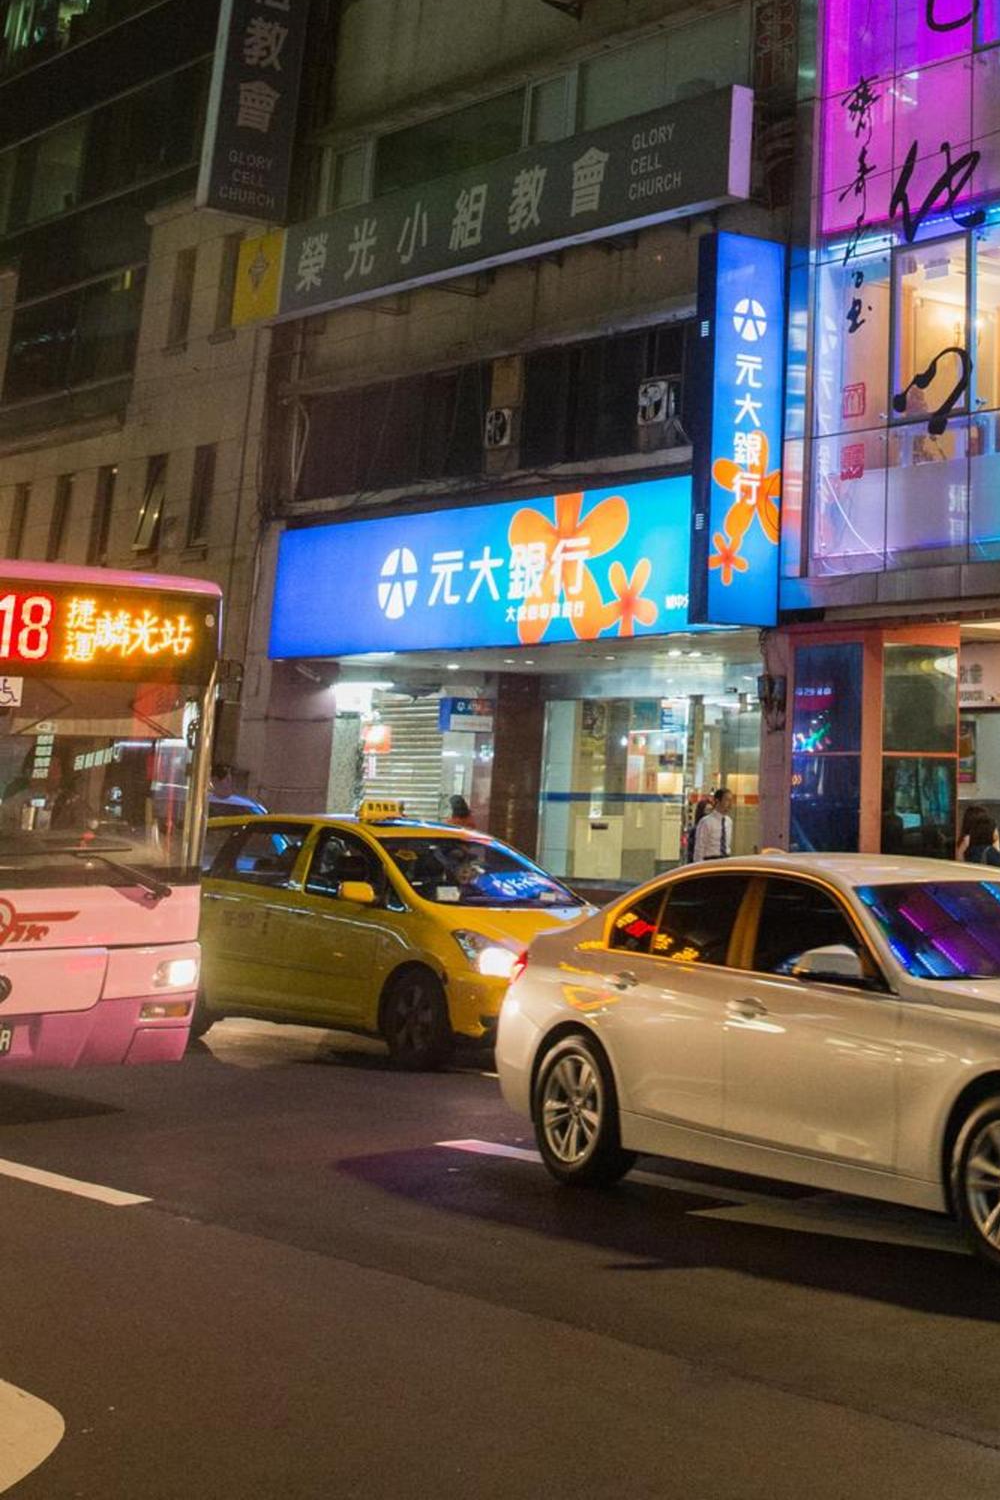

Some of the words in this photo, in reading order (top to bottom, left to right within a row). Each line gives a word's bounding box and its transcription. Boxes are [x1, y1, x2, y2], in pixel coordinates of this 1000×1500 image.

[632, 123, 675, 151] GLORY
[228, 149, 273, 172] GLORY
[631, 152, 662, 176] CELL
[232, 168, 264, 188] CELL
[628, 170, 682, 200] CHURCH
[219, 183, 275, 209] CHURCH
[296, 147, 609, 292] 榮光小組教會
[731, 353, 765, 506] 元大銀行
[427, 536, 591, 607] 元大銀行
